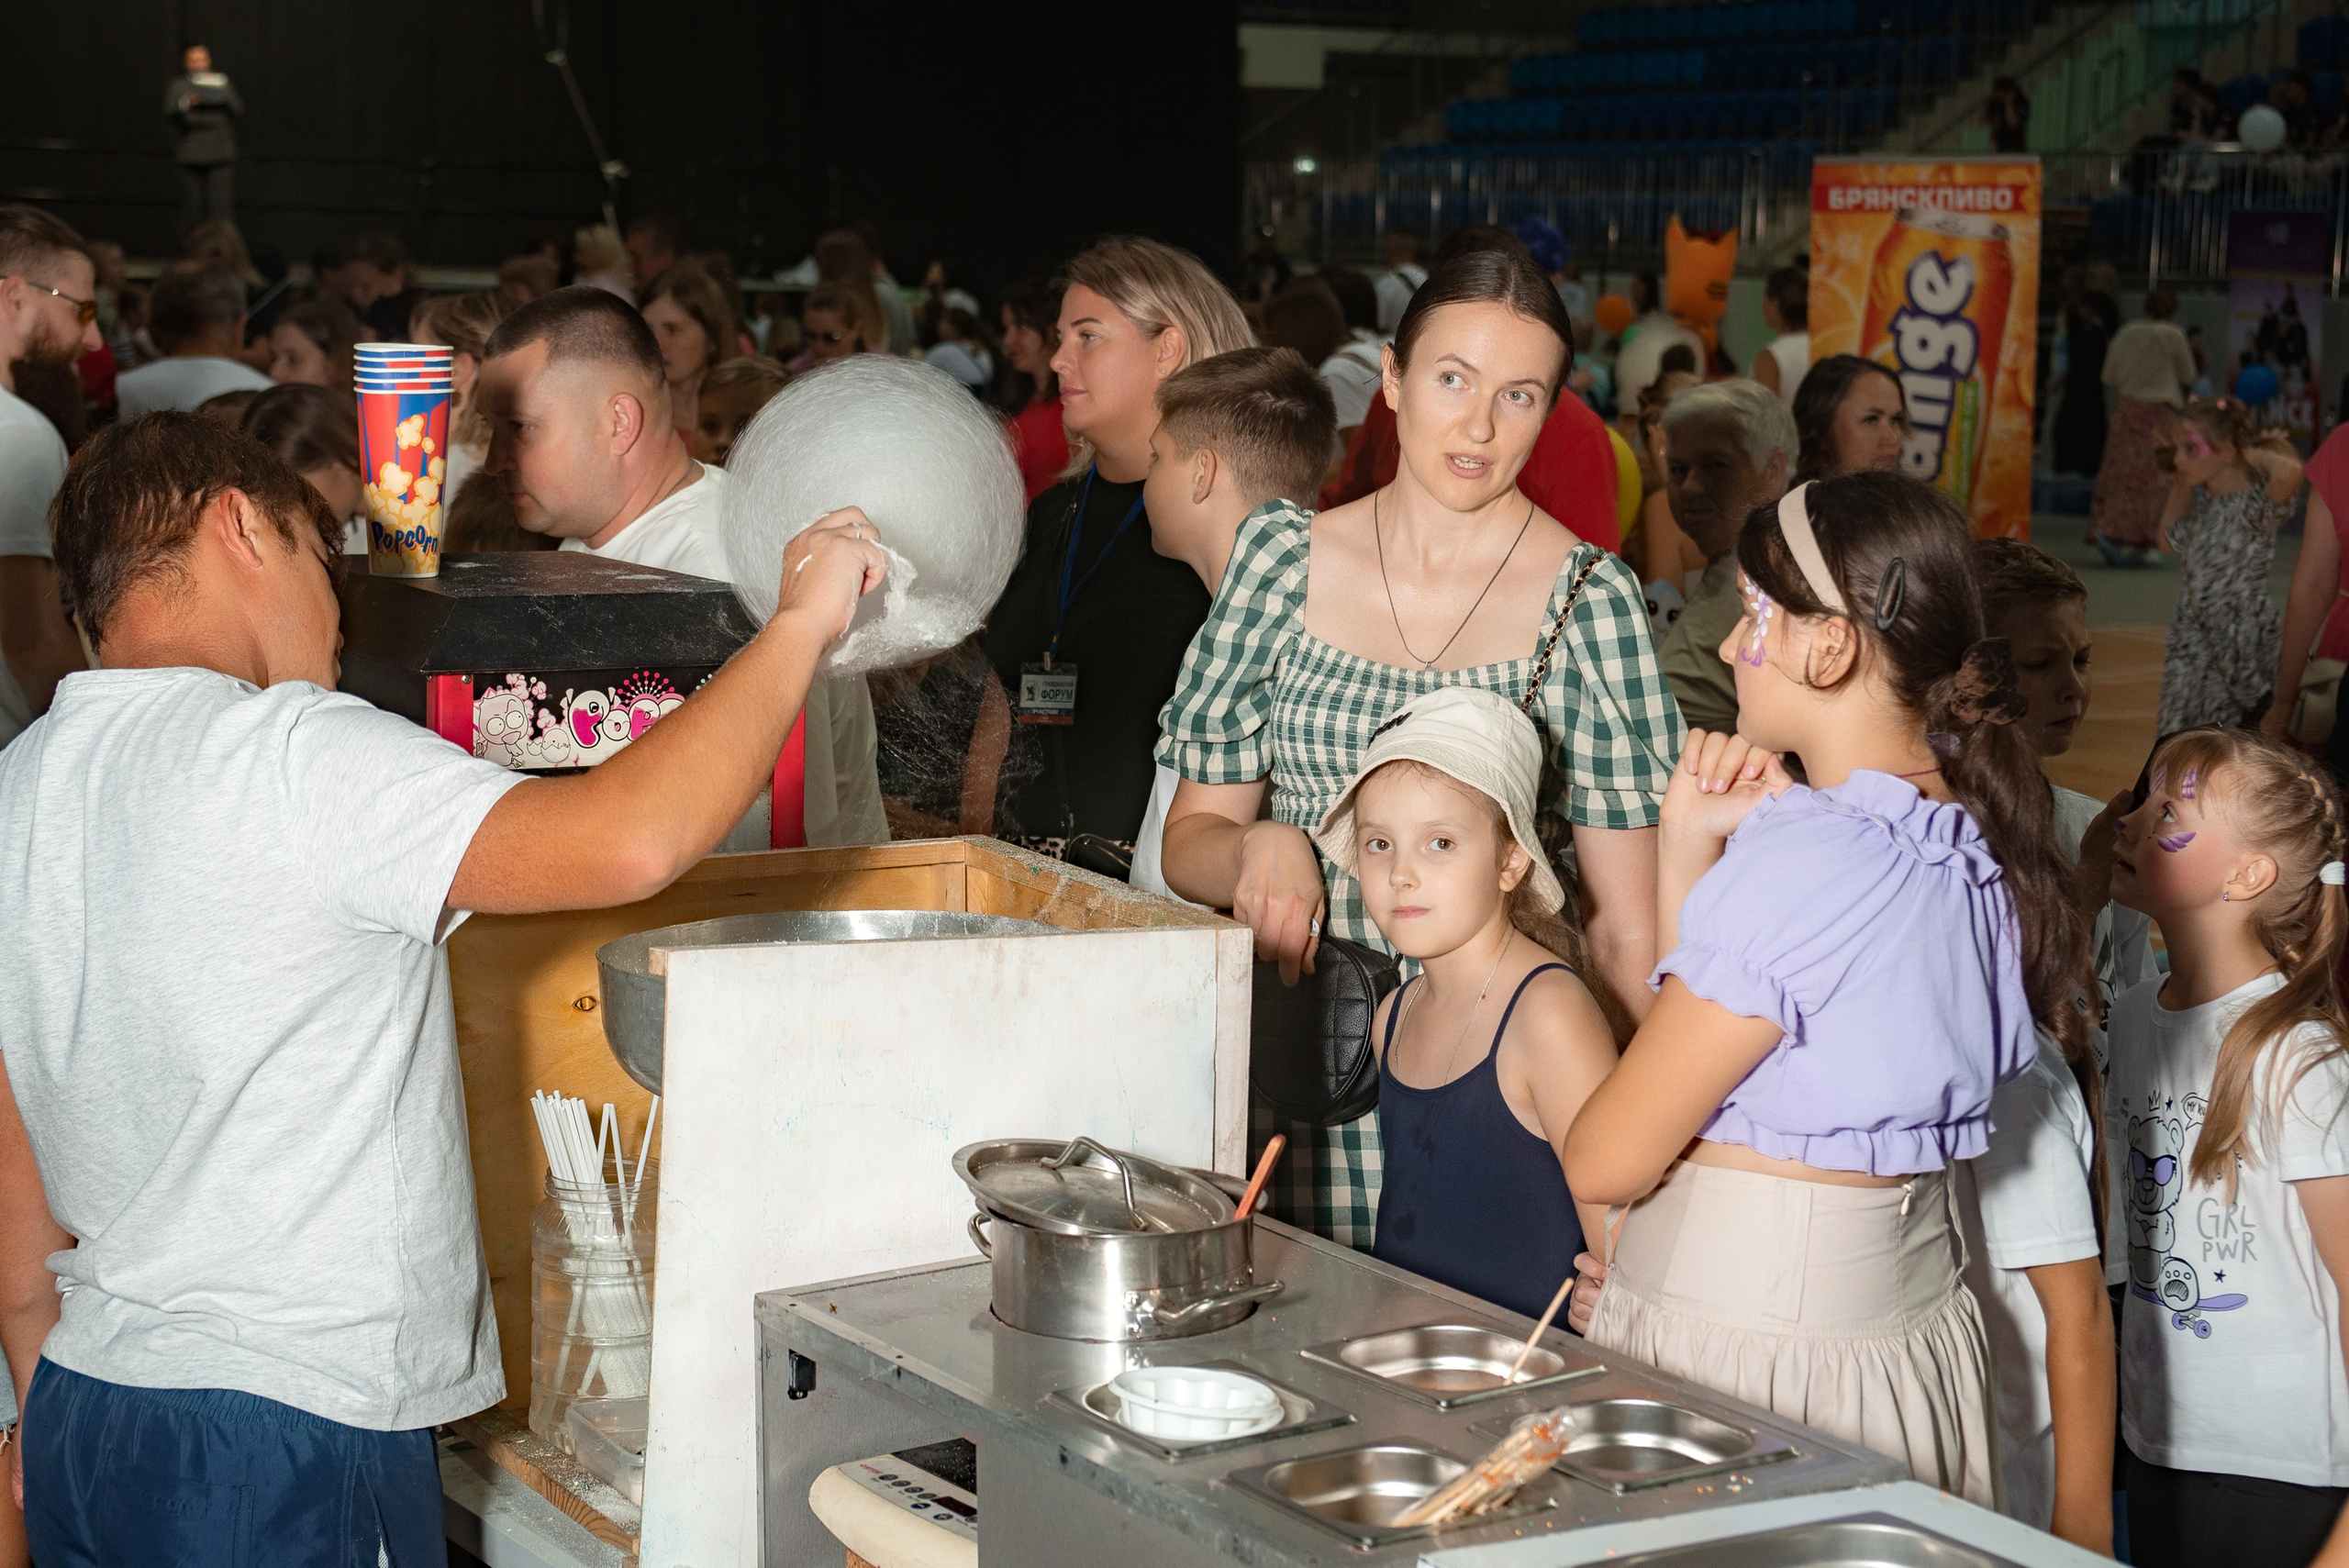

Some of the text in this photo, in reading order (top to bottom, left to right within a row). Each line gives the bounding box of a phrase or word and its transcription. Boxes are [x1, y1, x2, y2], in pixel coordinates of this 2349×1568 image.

[1827, 185, 2015, 211] БРЯНСКПИВО
[1889, 250, 1979, 483] ange
[1041, 689, 1074, 701] ФОРУМ
[2187, 1101, 2198, 1112] MY
[2197, 1197, 2256, 1240] GRL
[2202, 1231, 2258, 1263] PWR
